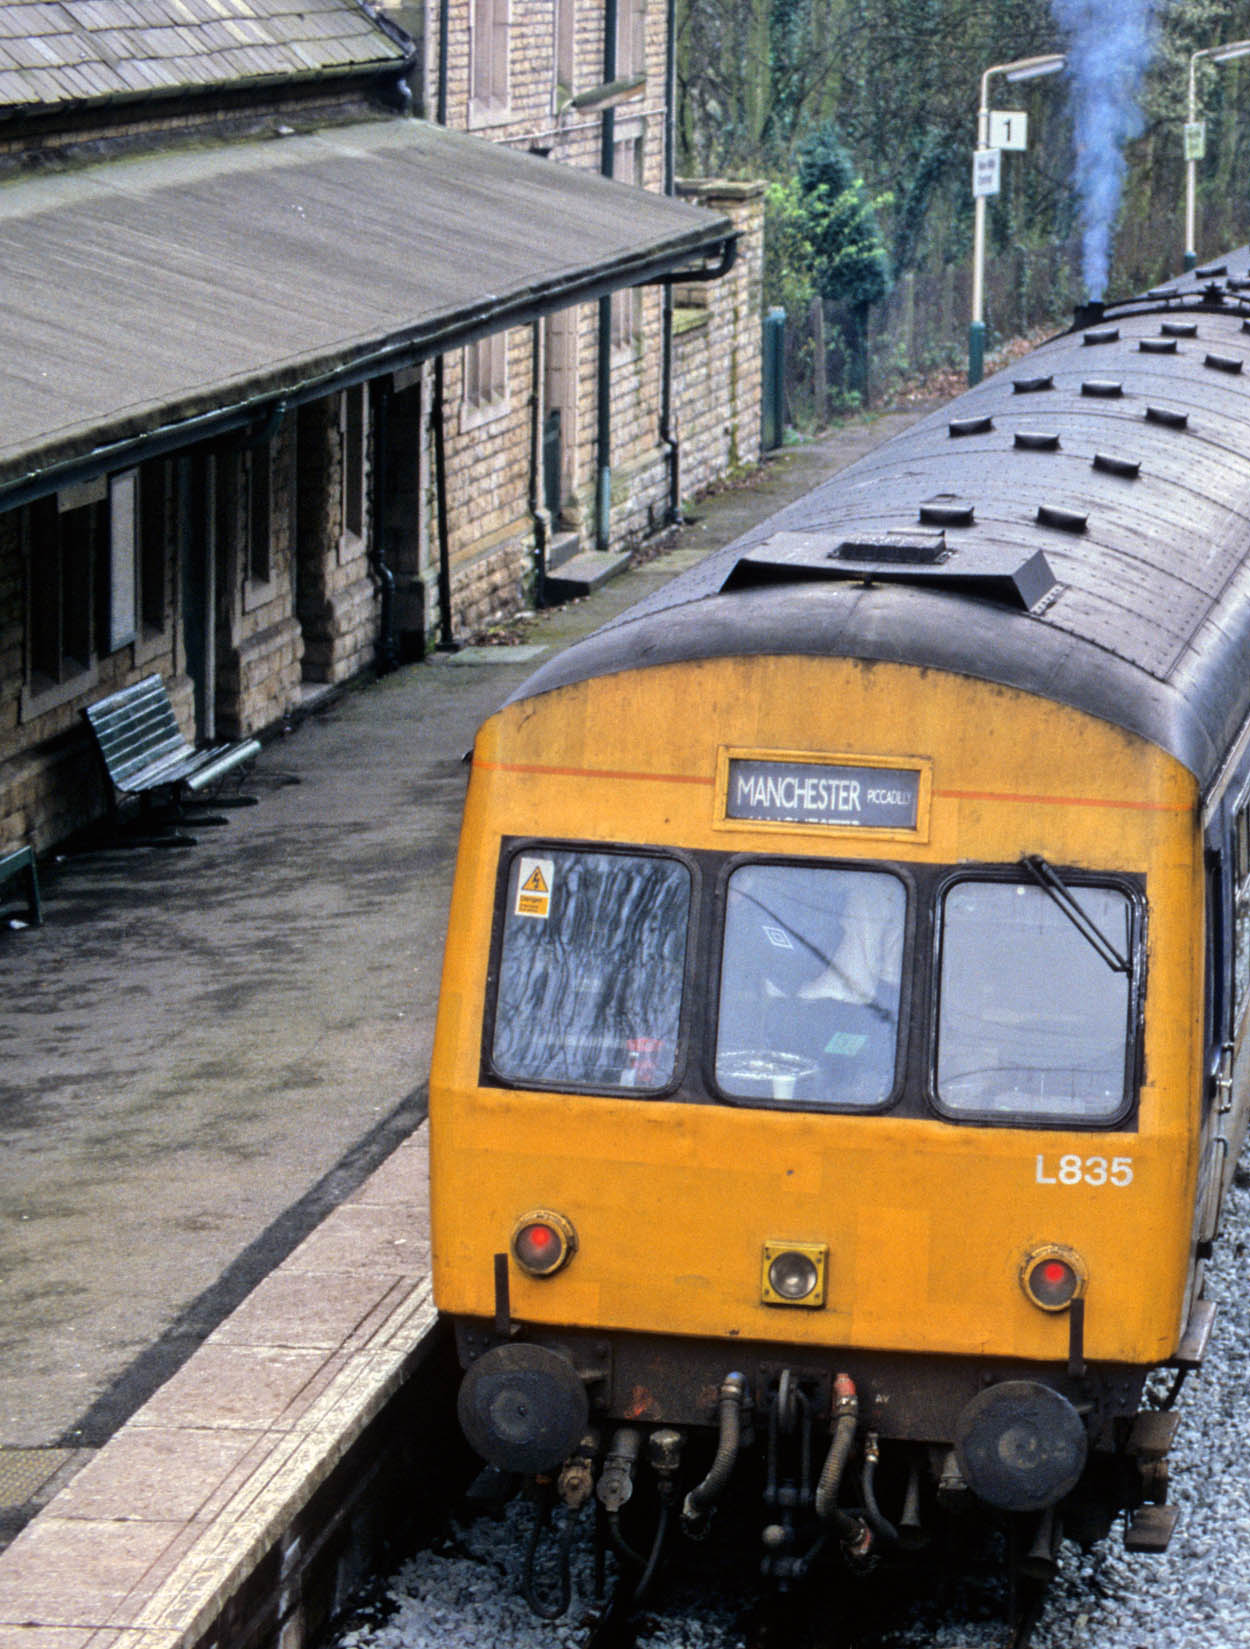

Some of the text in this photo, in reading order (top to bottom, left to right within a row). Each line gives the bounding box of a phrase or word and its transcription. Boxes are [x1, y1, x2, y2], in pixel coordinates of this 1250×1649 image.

[1003, 119, 1012, 142] 1
[736, 776, 912, 812] MANCHESTER PICCADILLY
[1036, 1154, 1134, 1187] L835
